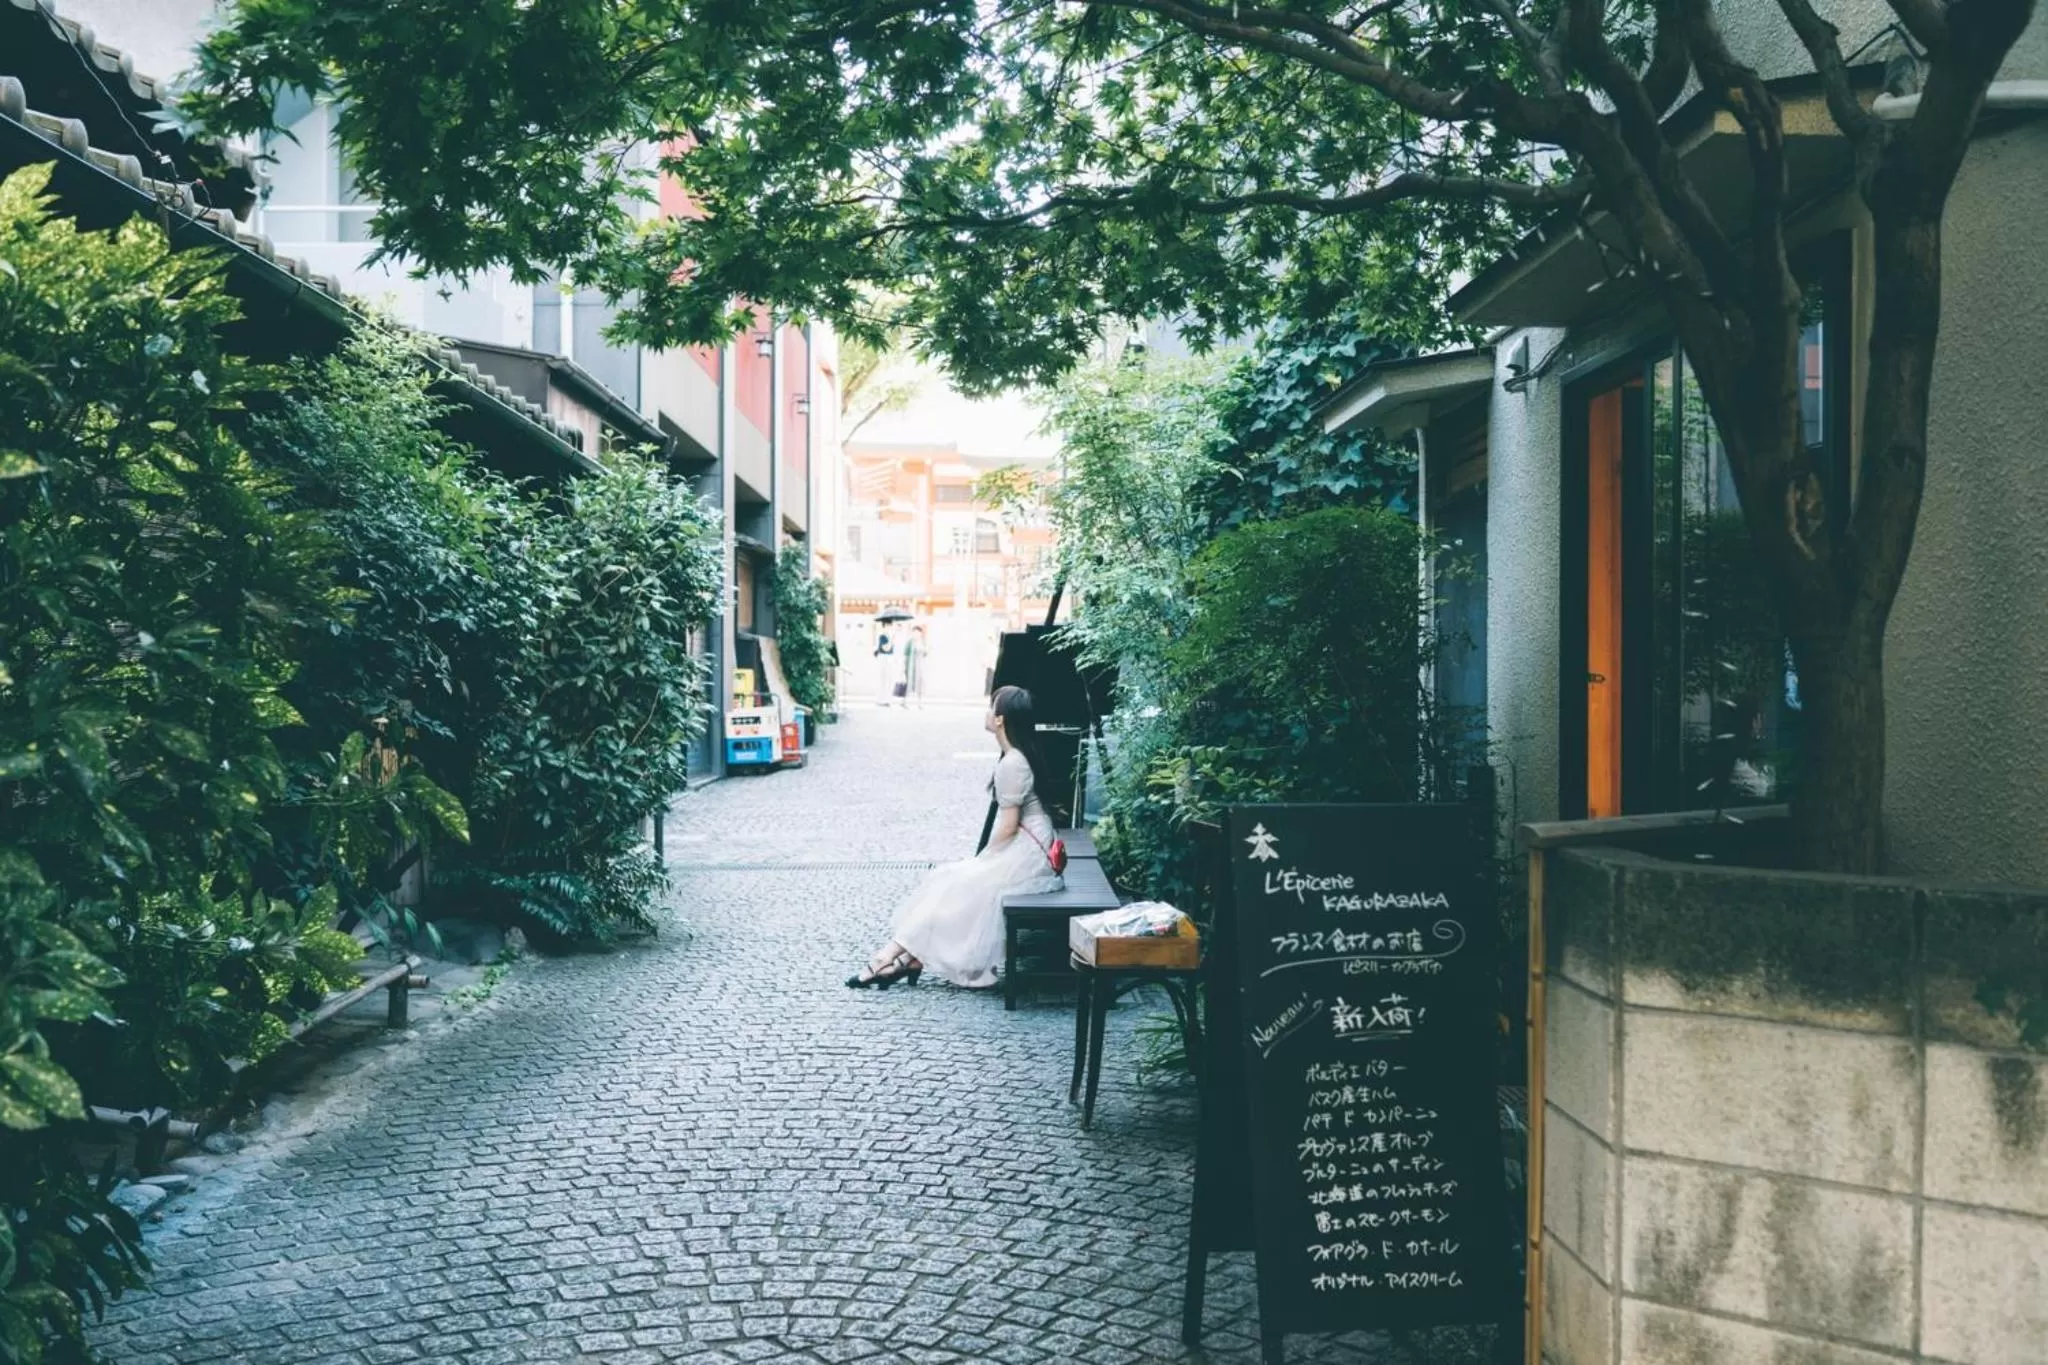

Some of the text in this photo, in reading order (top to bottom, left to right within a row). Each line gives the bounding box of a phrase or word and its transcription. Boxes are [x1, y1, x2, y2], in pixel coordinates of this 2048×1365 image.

[1322, 892, 1449, 911] KAGURAZAKA
[1271, 928, 1424, 952] フランス食材のお店
